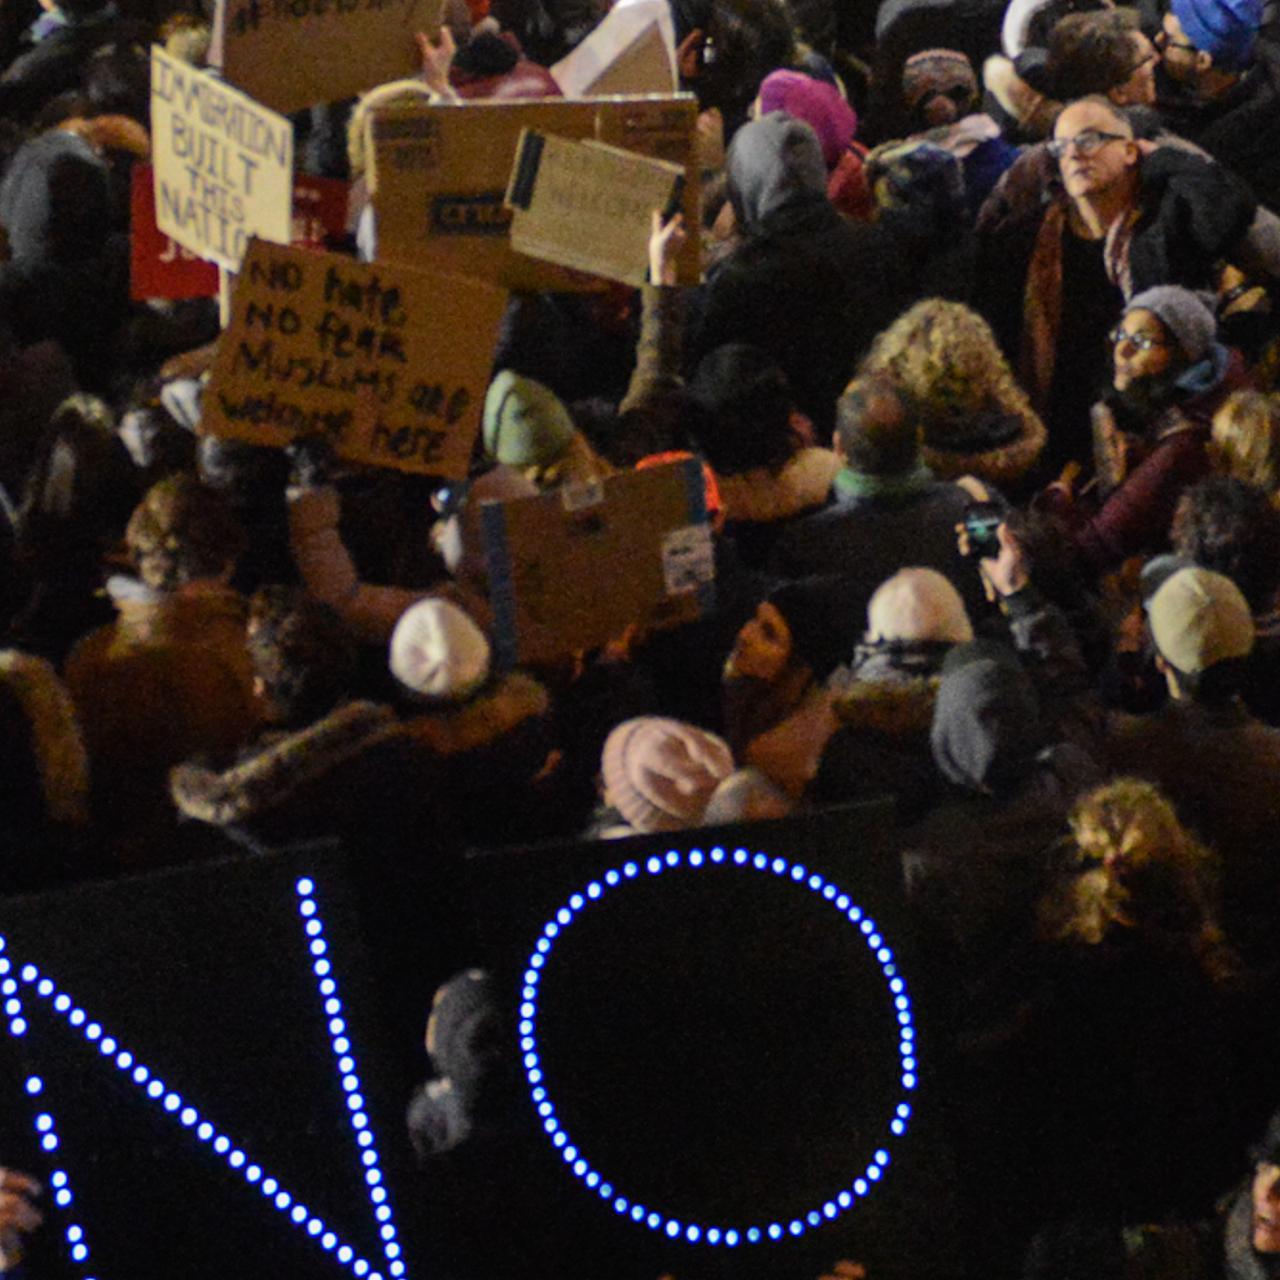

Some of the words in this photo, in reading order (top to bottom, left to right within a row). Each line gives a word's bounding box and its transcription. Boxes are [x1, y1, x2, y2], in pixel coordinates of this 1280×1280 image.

[171, 111, 259, 197] BUILT
[160, 181, 249, 261] NATIO
[185, 165, 246, 225] THIS
[248, 259, 304, 294] NO
[244, 301, 303, 337] NO
